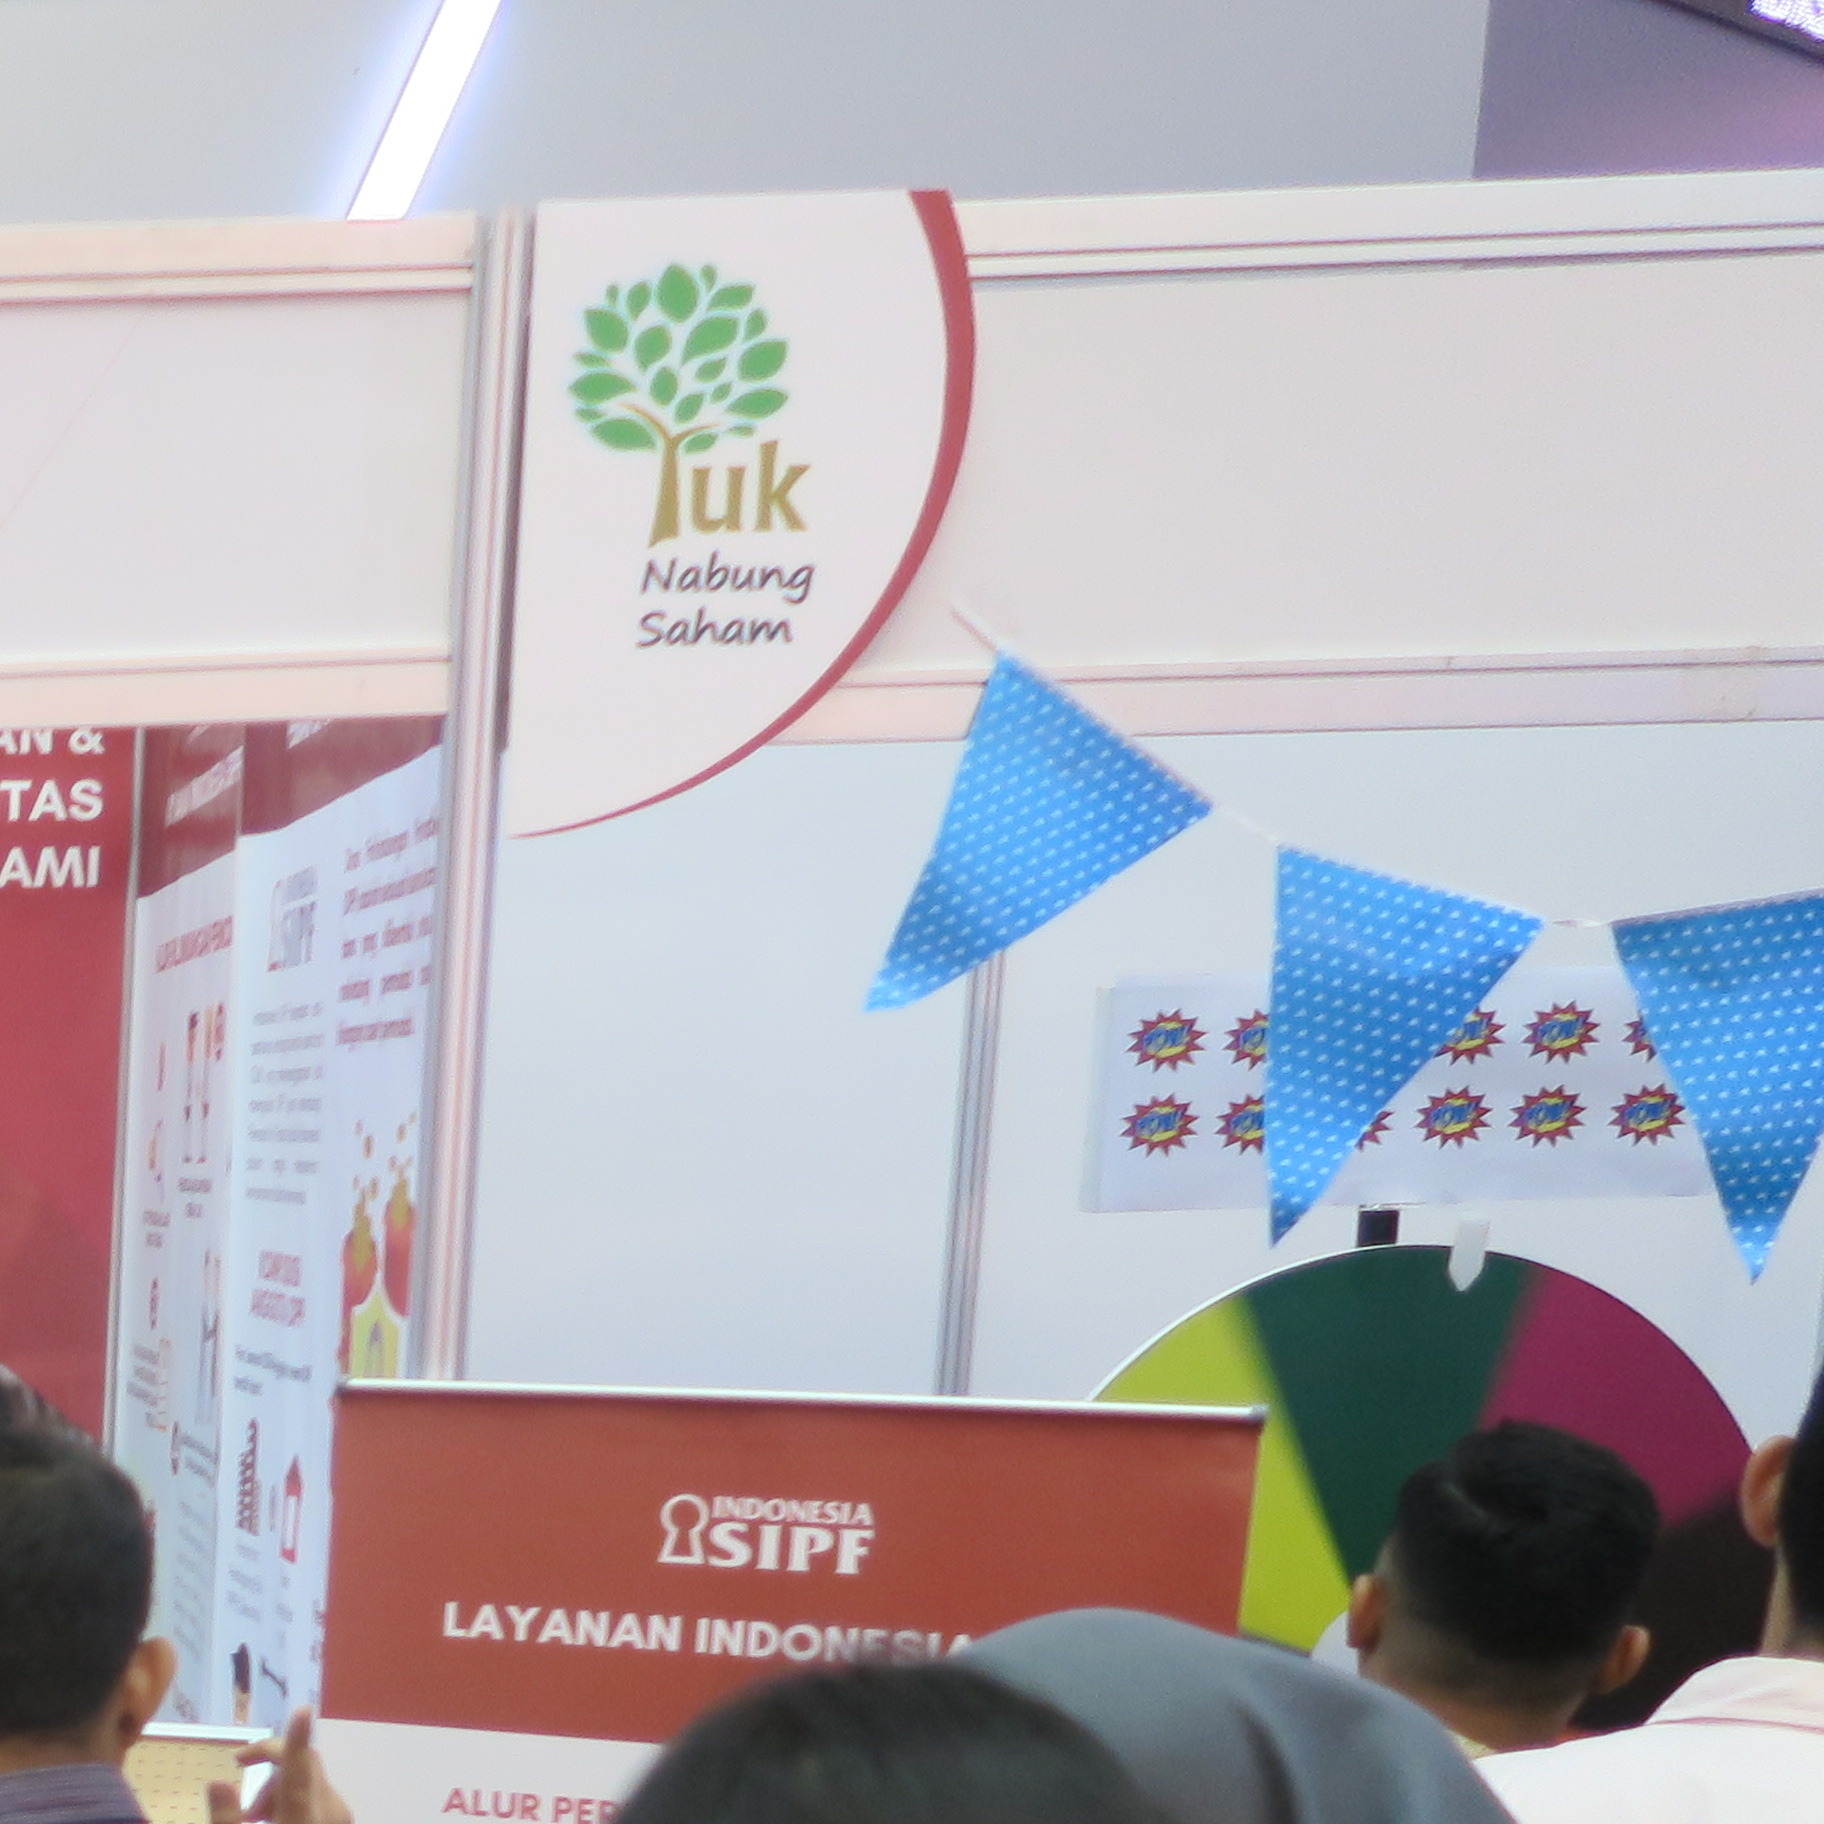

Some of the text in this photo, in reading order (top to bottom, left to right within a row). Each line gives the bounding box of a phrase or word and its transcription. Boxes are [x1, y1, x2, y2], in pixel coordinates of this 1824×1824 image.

[641, 551, 815, 604] Nabung
[636, 607, 793, 648] Saham
[710, 1495, 875, 1526] INDONESIA
[707, 1521, 876, 1575] SIPF
[443, 1601, 683, 1652] LAYANAN
[441, 1787, 542, 1822] ALUR
